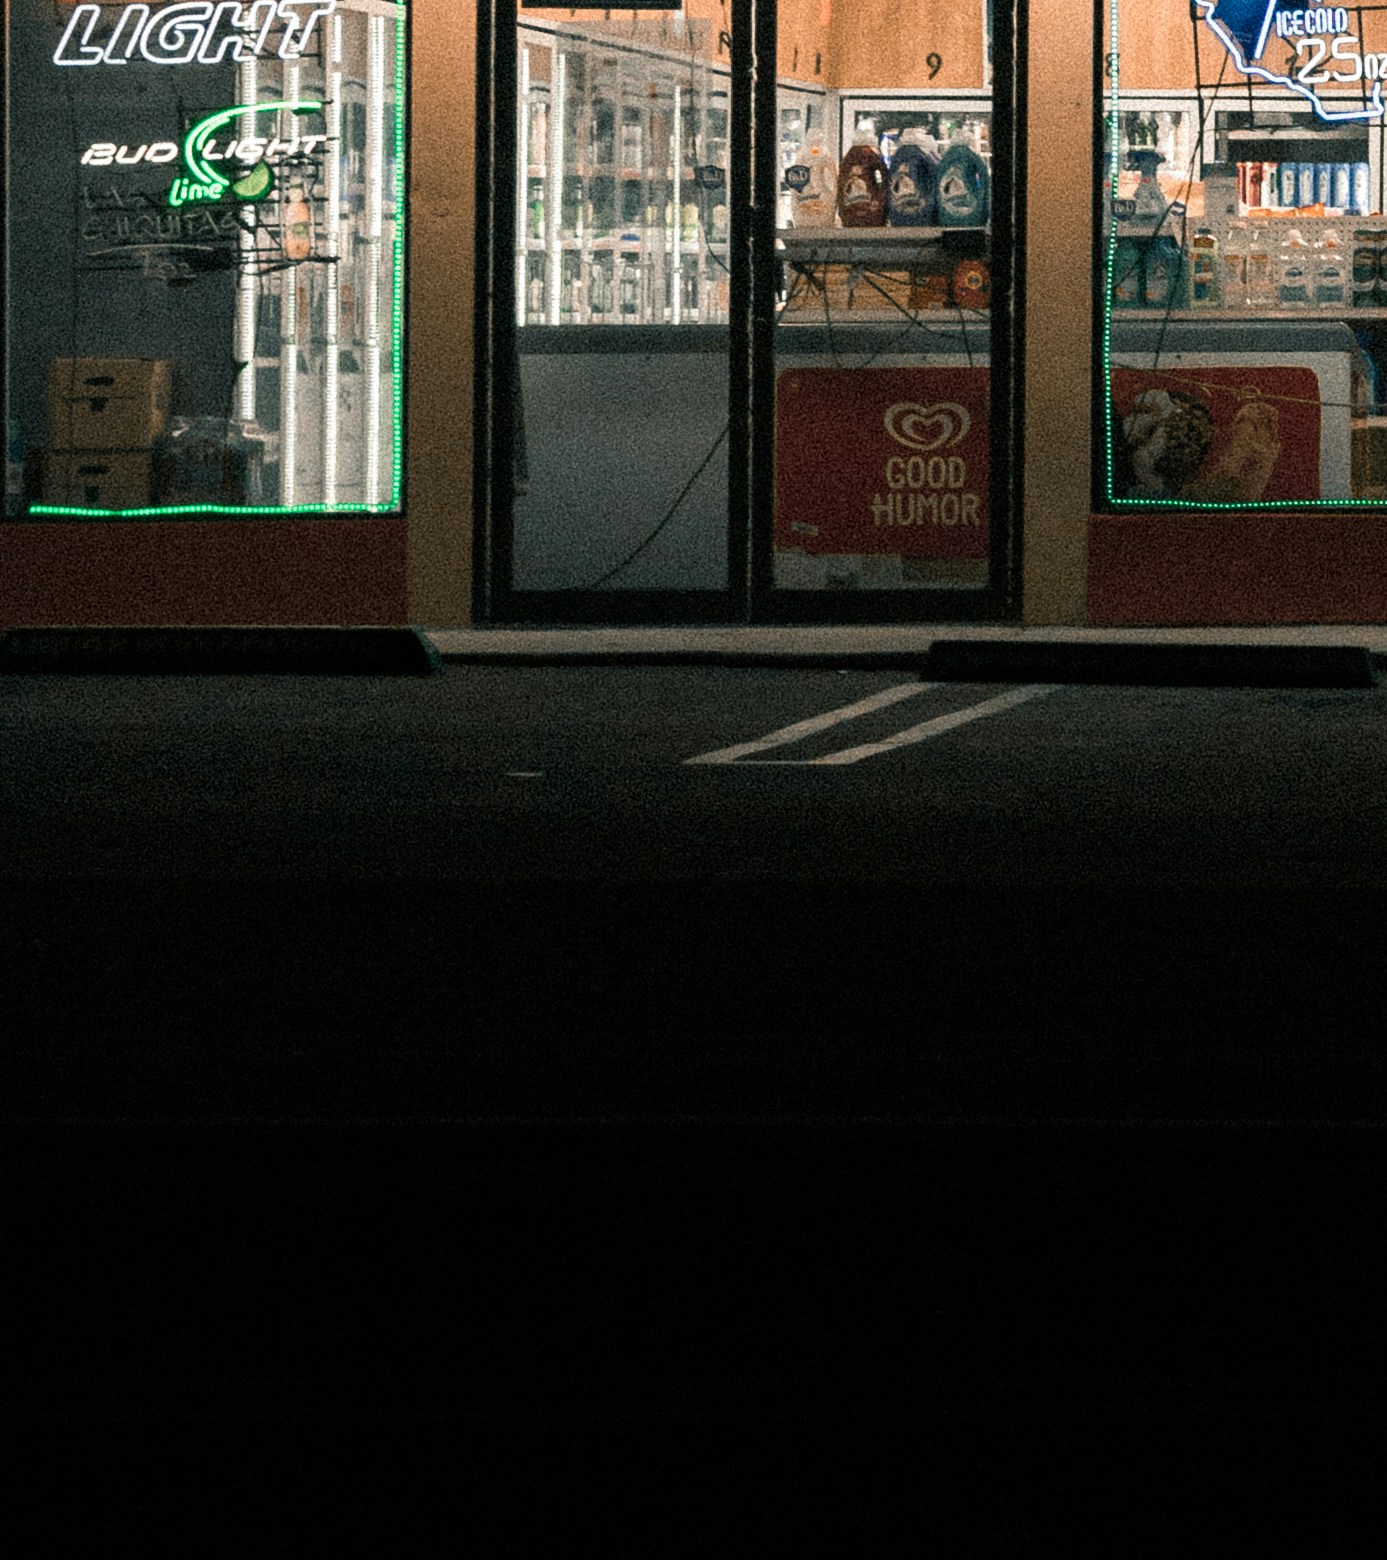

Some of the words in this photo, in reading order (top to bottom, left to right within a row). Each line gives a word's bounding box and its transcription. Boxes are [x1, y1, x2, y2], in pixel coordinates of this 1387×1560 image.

[926, 52, 943, 80] 9
[80, 142, 179, 166] BUD
[201, 134, 328, 161] LIGHT
[886, 455, 966, 489] GOOD
[871, 492, 982, 526] HUMOR
